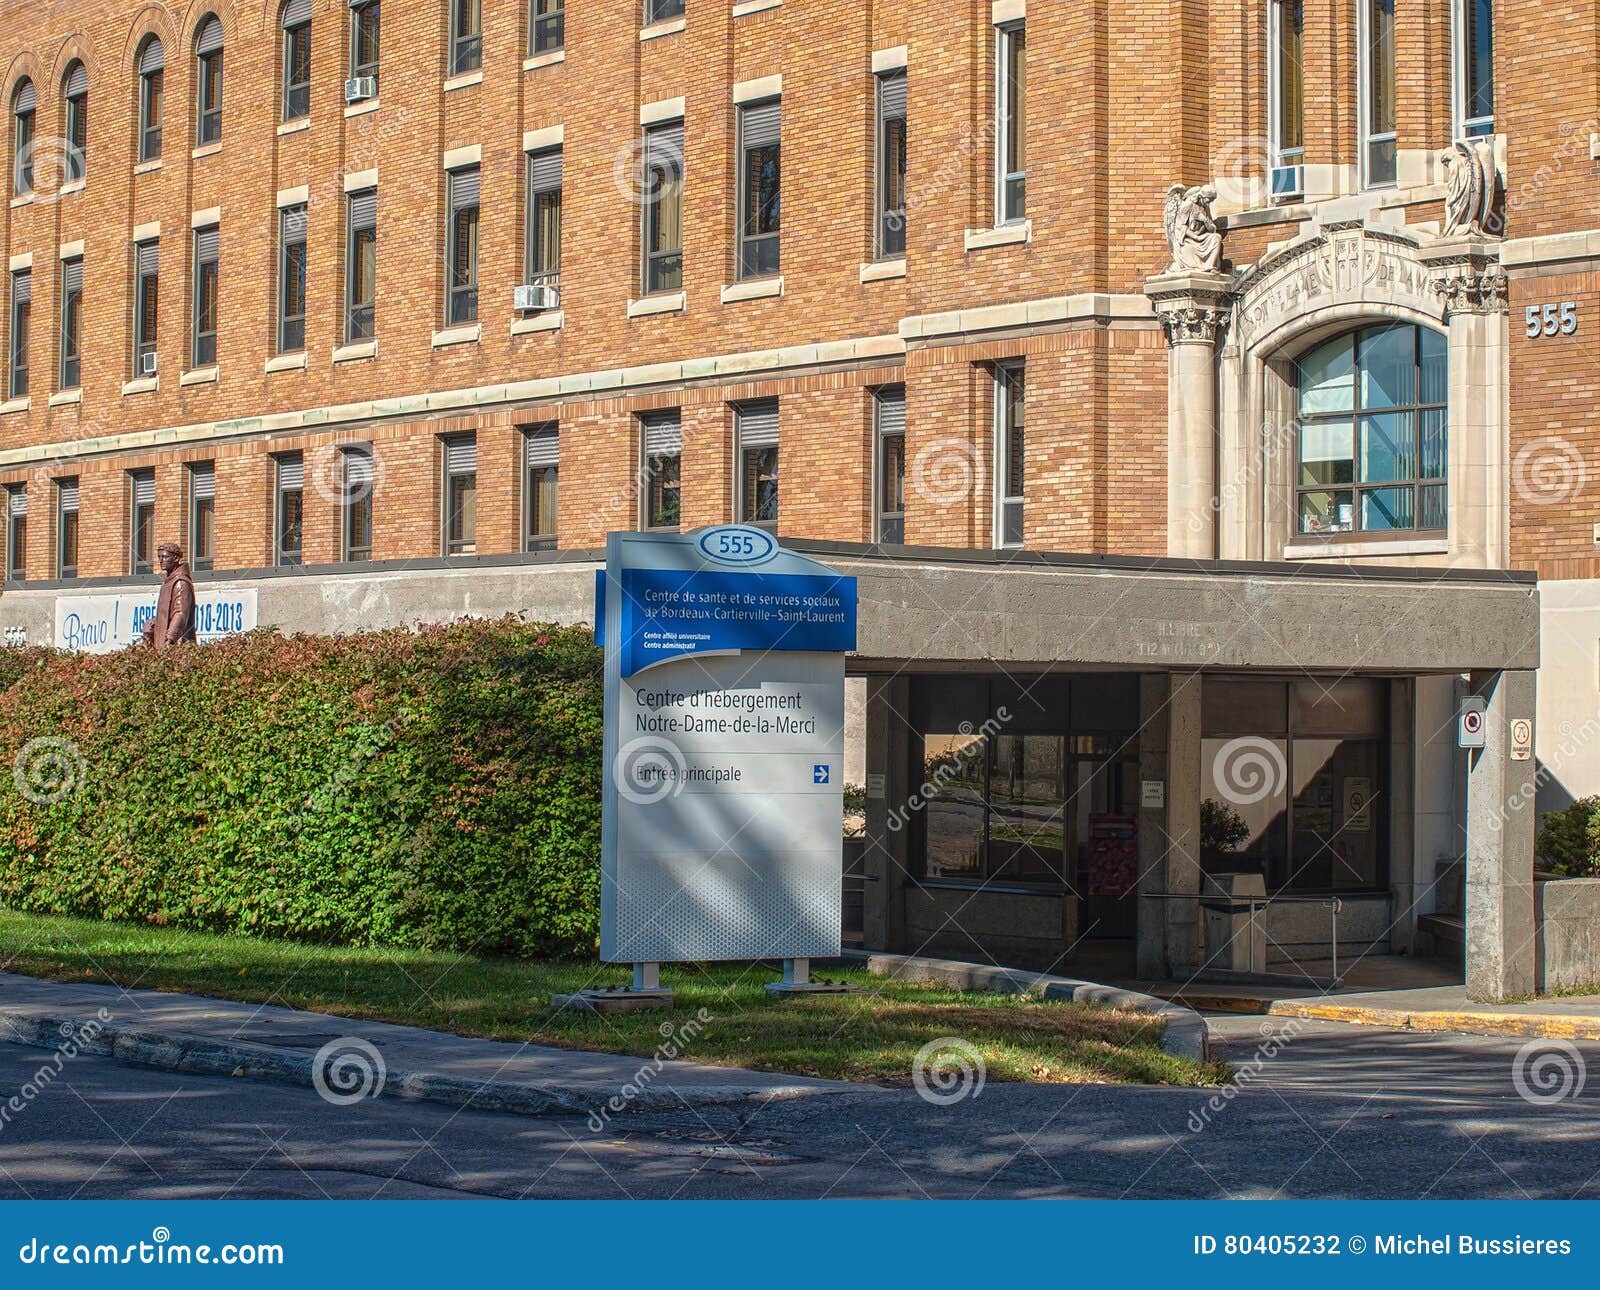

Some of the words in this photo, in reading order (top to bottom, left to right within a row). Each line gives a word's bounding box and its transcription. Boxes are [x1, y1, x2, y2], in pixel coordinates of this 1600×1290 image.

[1525, 301, 1577, 338] 555
[719, 535, 753, 554] 555
[645, 589, 679, 602] Centre
[682, 591, 696, 603] de
[699, 592, 727, 605] santé
[730, 594, 741, 605] et
[743, 593, 756, 605] de
[759, 594, 800, 606] services
[802, 595, 840, 607] sociaux
[132, 600, 157, 632] AGRÉ
[194, 603, 242, 631] 010-2013
[645, 606, 658, 618] de
[4, 626, 27, 648] 555
[63, 613, 107, 650] Bravo
[644, 631, 662, 640] Centre
[678, 632, 711, 641] universitaire
[644, 641, 662, 650] Centre
[662, 641, 696, 650] administratif
[636, 689, 684, 707] Centre
[690, 689, 802, 712] d'hébergement
[636, 714, 815, 734] Notre-Dame-de-la-Merci
[636, 765, 677, 782] Entrée
[681, 765, 742, 784] principale
